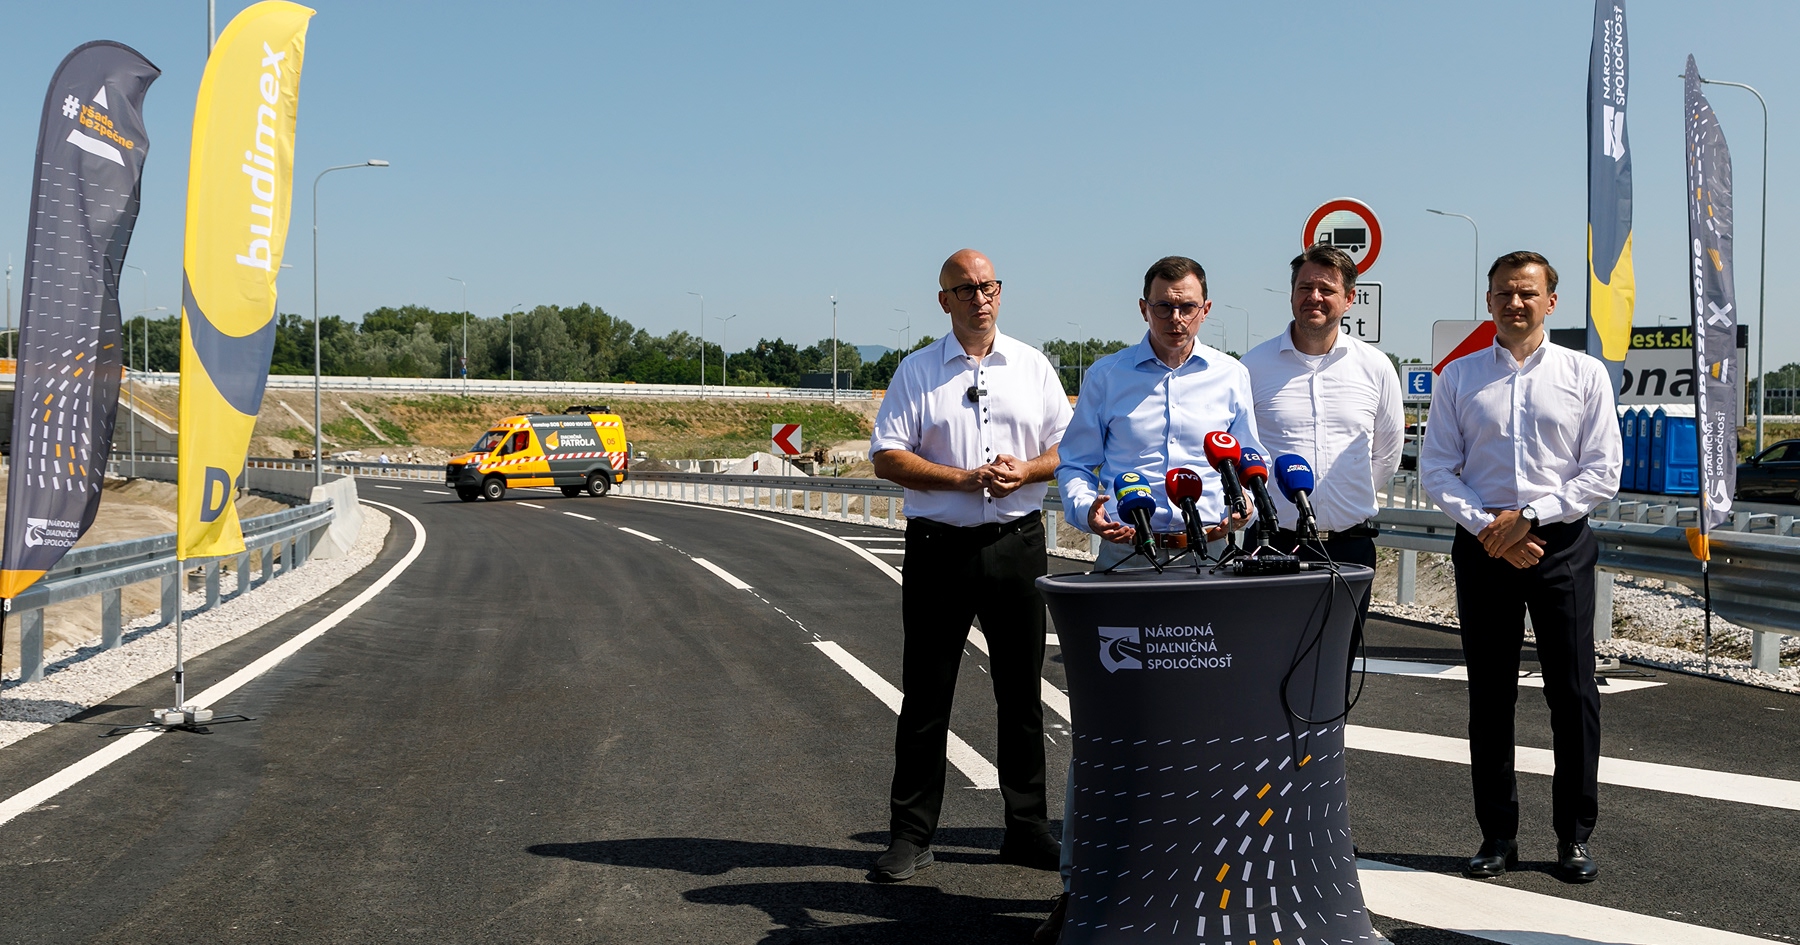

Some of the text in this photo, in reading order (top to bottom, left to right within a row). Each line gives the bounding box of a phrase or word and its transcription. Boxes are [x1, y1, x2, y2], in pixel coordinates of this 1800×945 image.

[79, 112, 134, 150] bezpečne
[236, 41, 285, 272] budimex
[1340, 316, 1366, 337] 5 t
[1631, 328, 1692, 348] est.sk
[560, 438, 596, 447] PATROLA
[48, 518, 80, 529] NÁRODNÁ
[1145, 622, 1214, 637] NÁRODNÁ
[1146, 638, 1218, 654] DIAĽNIČNÁ
[1147, 653, 1232, 669] SPOLOČNOSŤ
